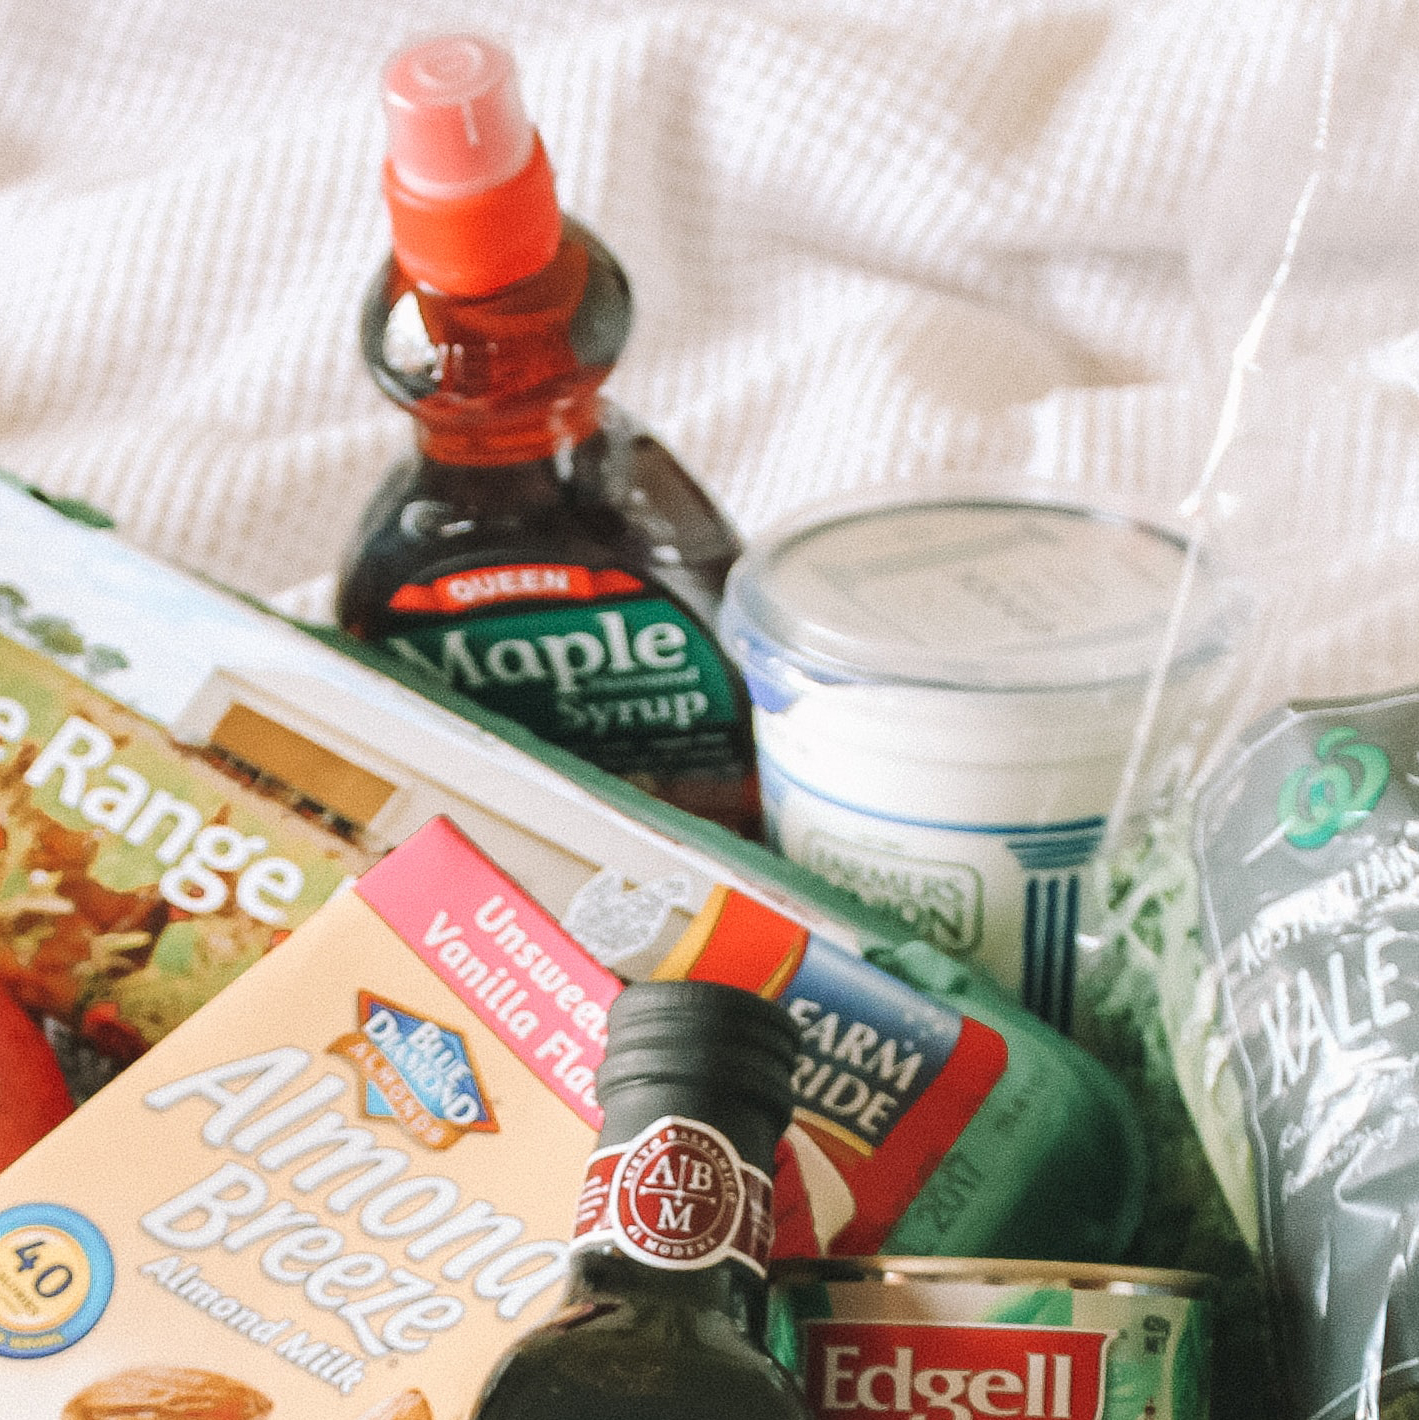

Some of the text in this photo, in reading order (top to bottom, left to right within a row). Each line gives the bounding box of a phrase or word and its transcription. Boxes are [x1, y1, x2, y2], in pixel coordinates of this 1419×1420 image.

[448, 569, 570, 601] QUEEN
[388, 611, 687, 694] Maple
[24, 716, 305, 926] Range
[423, 910, 540, 1041] Vanilla
[15, 1240, 73, 1298] 40
[138, 1160, 466, 1359] Breeze
[138, 1254, 293, 1346] Almond
[279, 1328, 368, 1396] Milk
